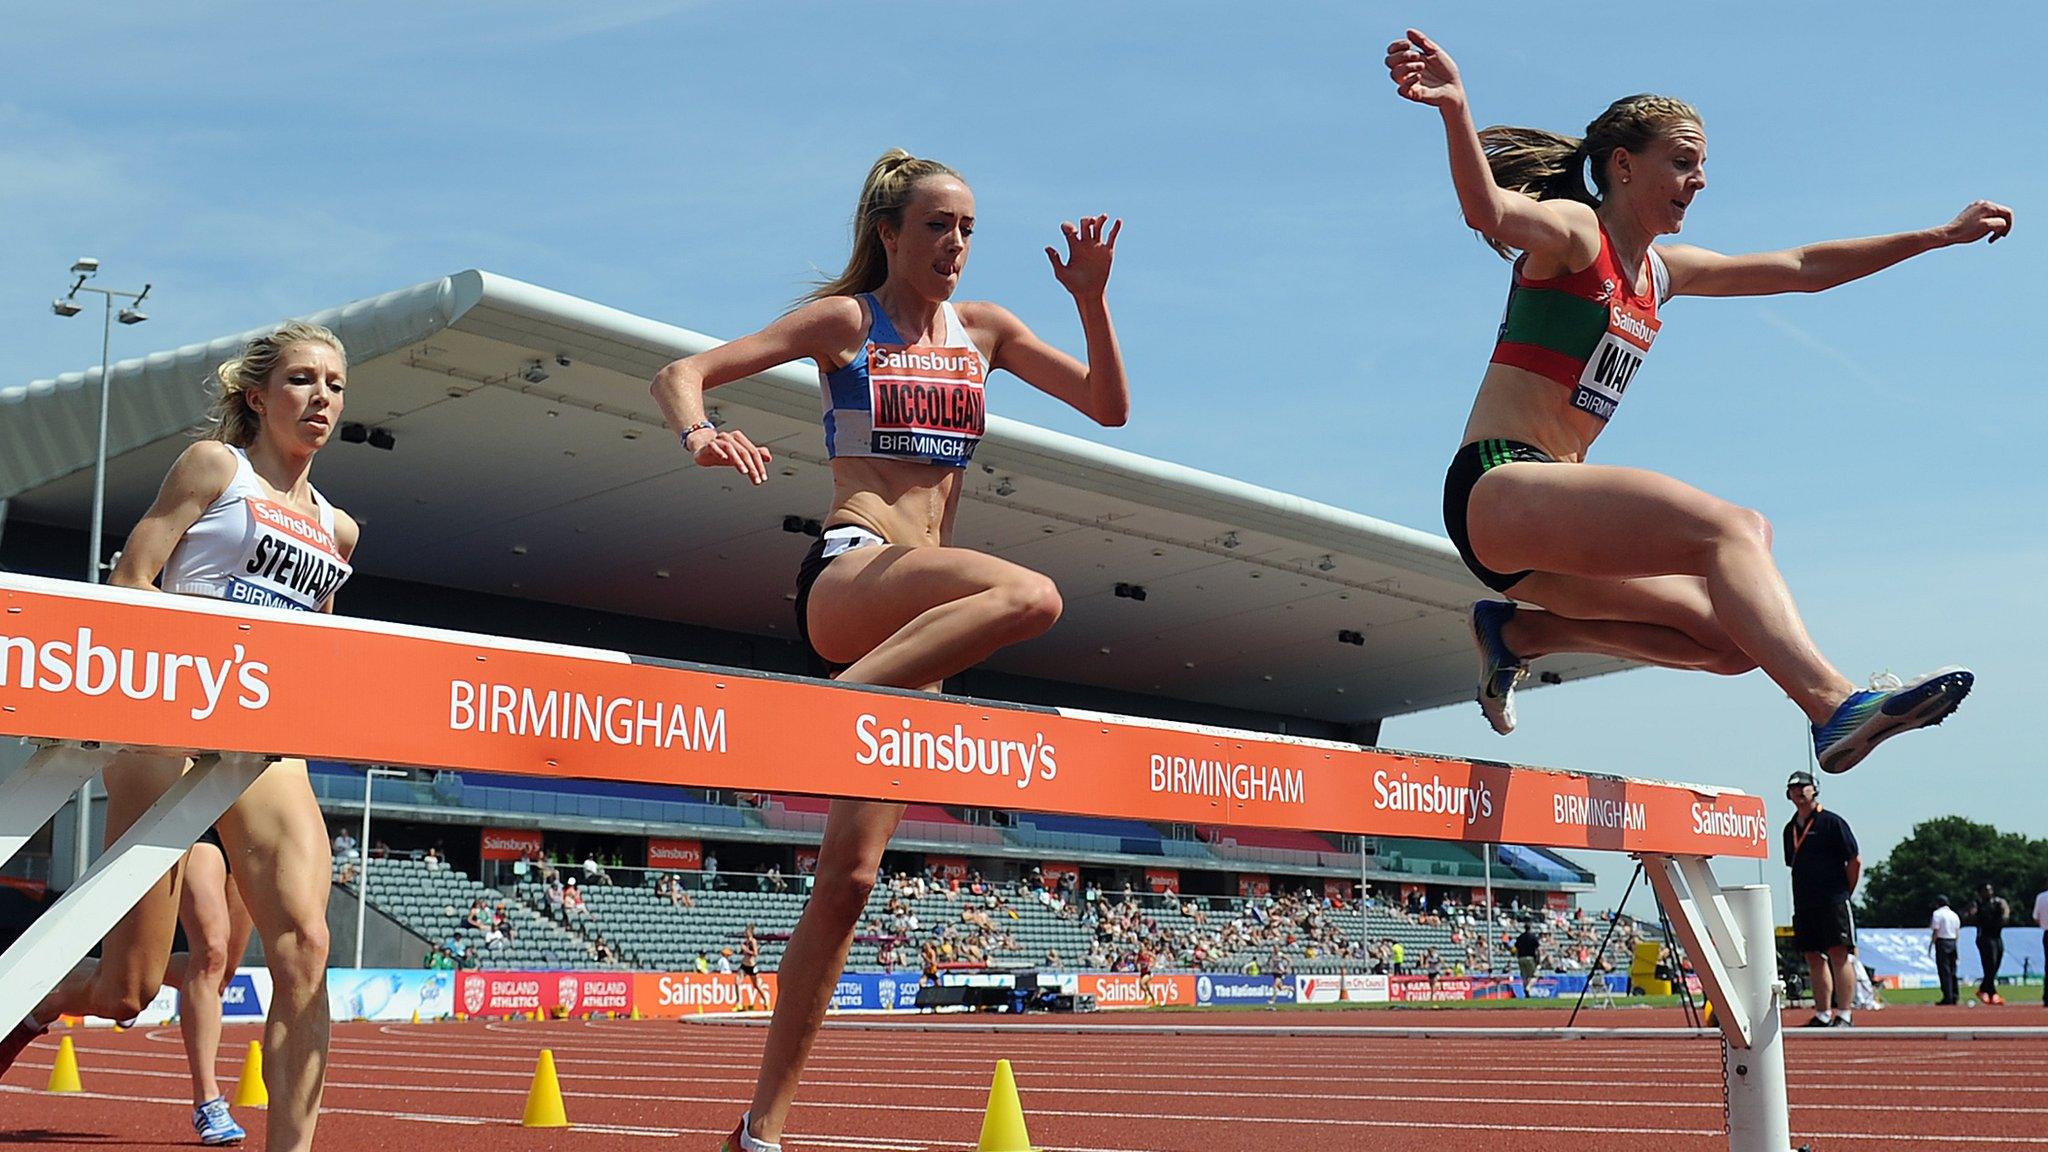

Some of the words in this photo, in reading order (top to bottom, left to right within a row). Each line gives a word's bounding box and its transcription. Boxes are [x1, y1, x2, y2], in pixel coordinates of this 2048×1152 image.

[247, 534, 346, 603] STEWART
[450, 680, 726, 753] BIRMINGHAM
[855, 713, 1057, 789] Sainsbury's
[1150, 753, 1305, 804] BIRMINGHAM
[1372, 770, 1493, 825] Sainsbury's
[1553, 793, 1646, 831] BIRMINGHAM
[1692, 802, 1767, 846] Sainsbury's
[490, 996, 540, 1008] ATHLETICS
[491, 981, 540, 995] ENGLAND
[582, 996, 627, 1007] ATHLETICS
[583, 981, 627, 995] ENGLAND
